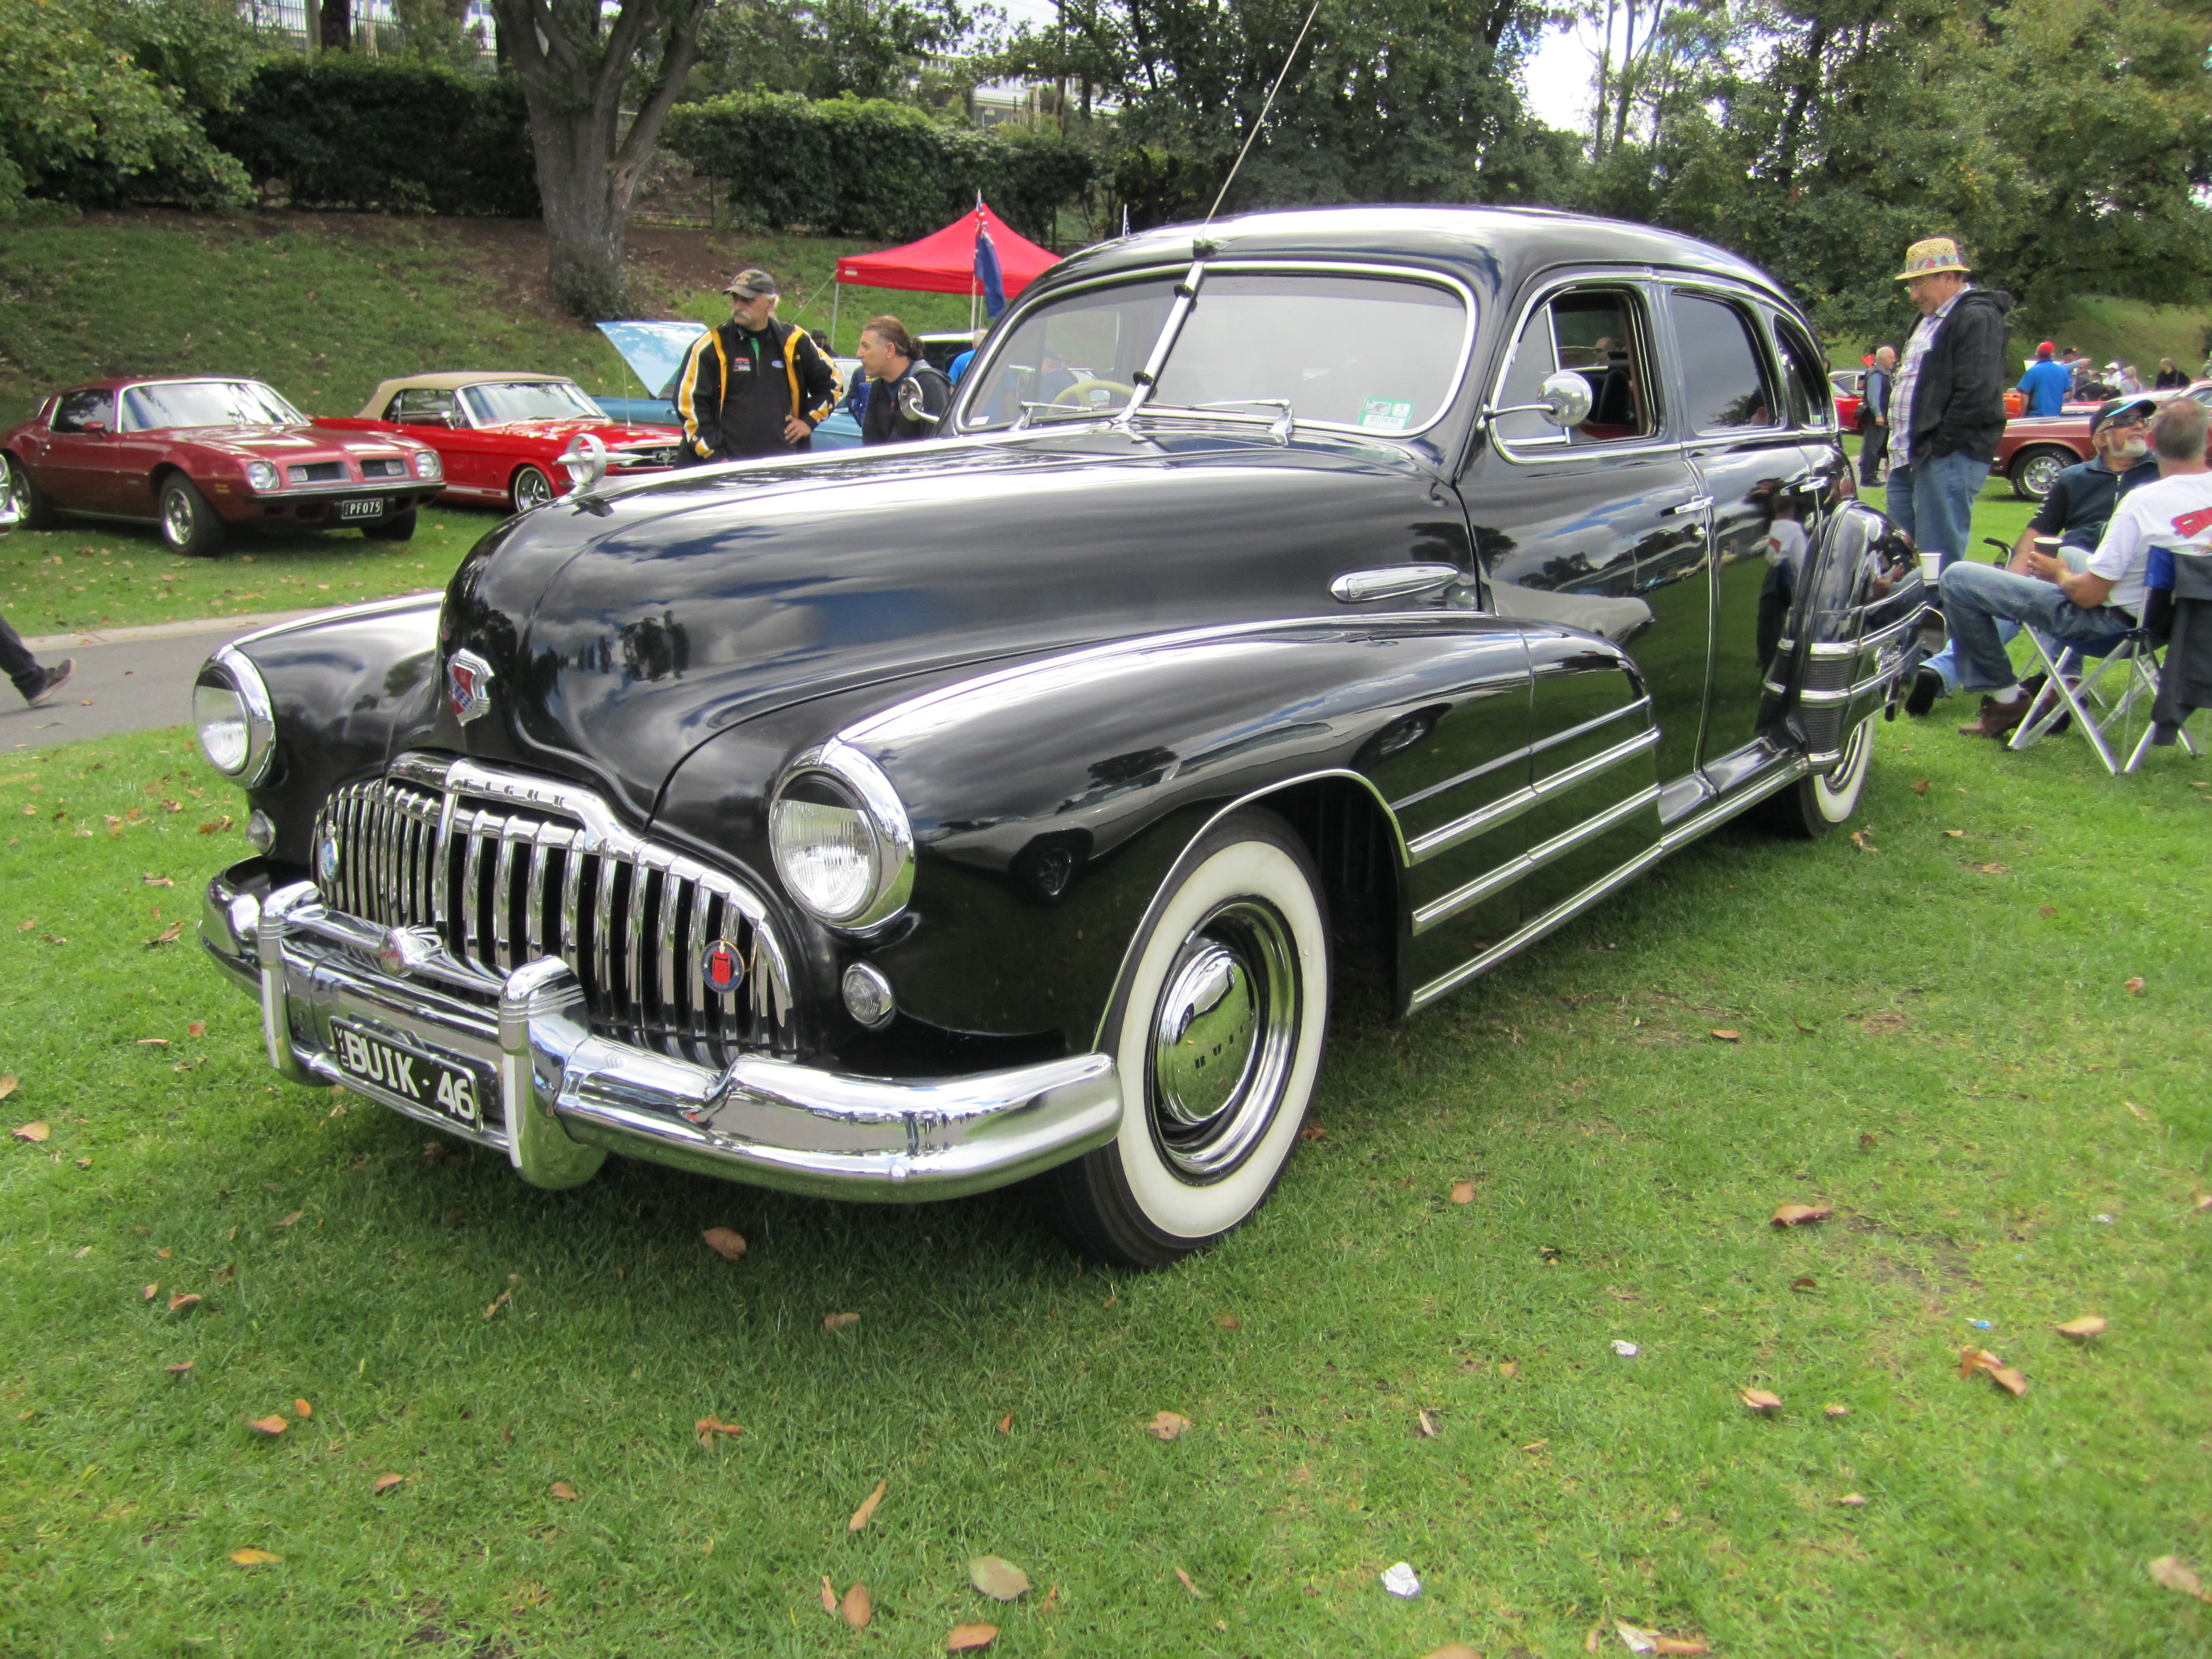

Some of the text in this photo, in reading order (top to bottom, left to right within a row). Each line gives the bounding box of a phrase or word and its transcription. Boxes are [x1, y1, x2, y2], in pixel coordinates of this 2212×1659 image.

[1397, 405, 1405, 413] 5
[1369, 415, 1399, 424] BUIK46
[335, 1027, 350, 1068] VIC
